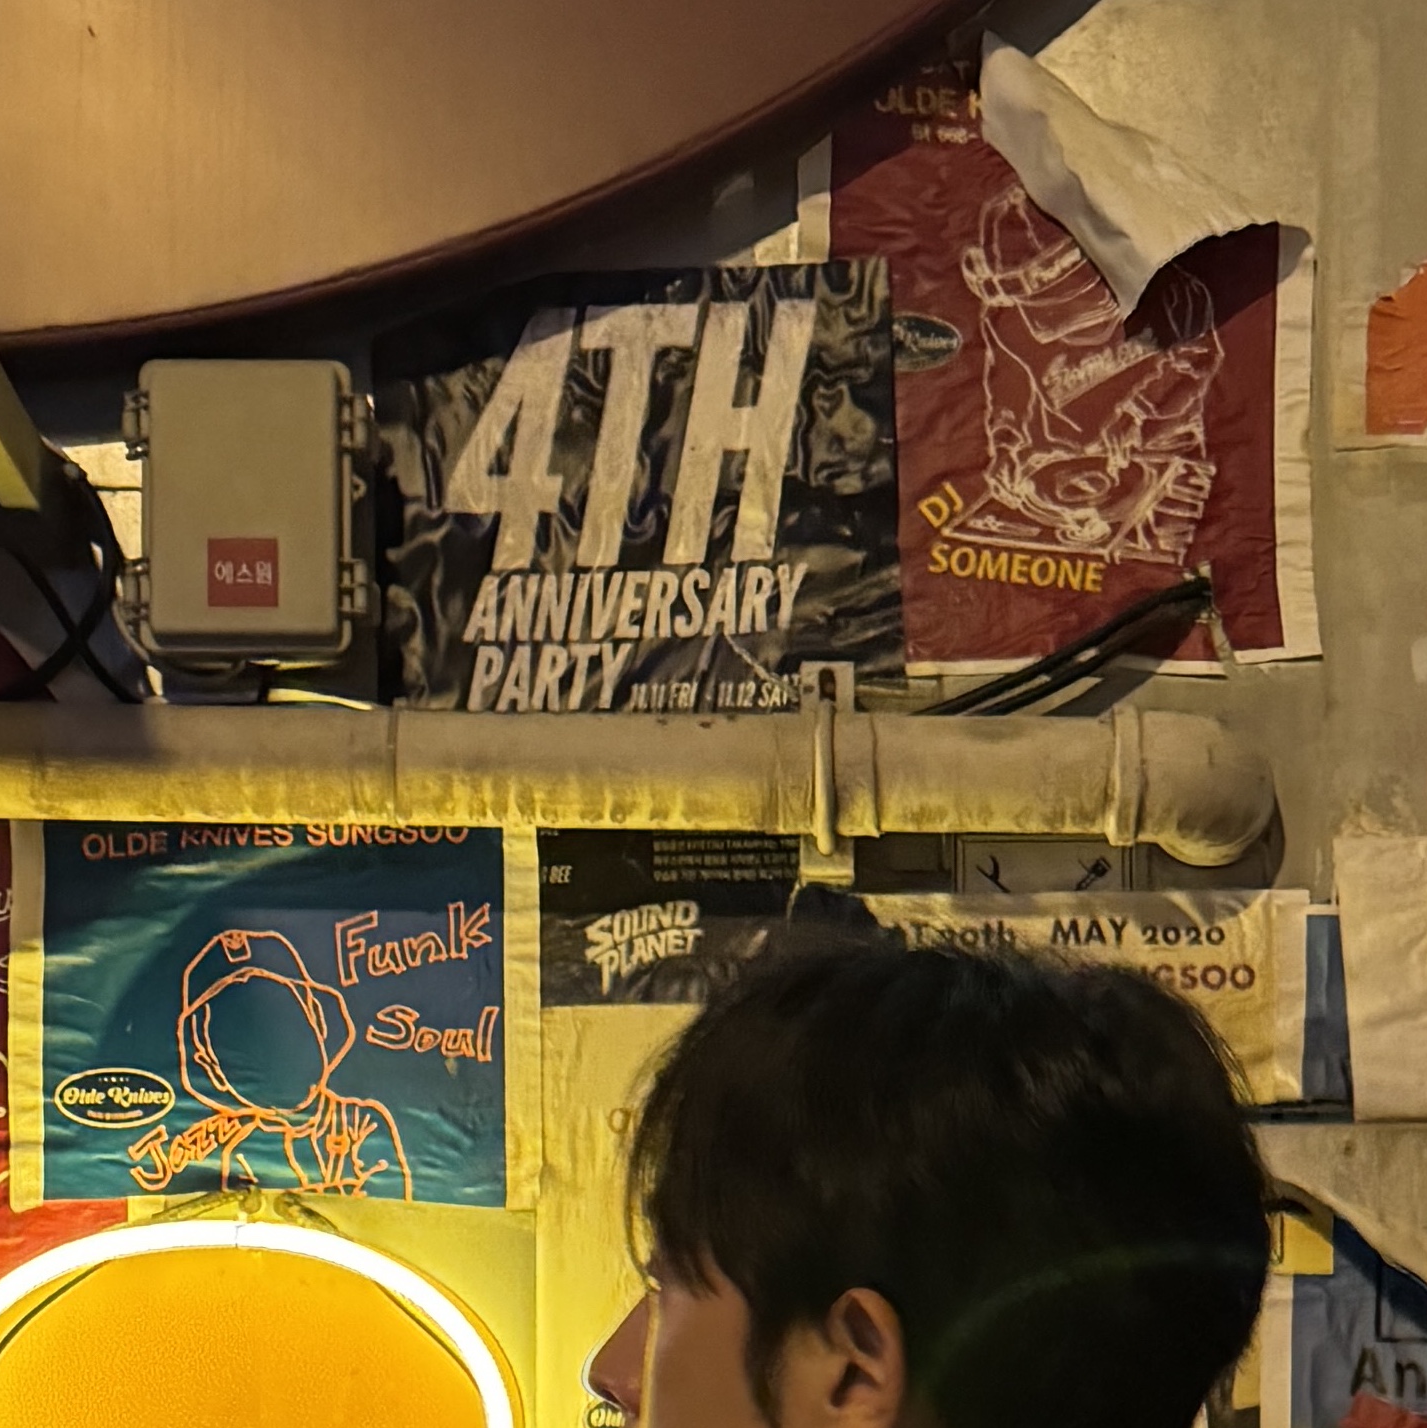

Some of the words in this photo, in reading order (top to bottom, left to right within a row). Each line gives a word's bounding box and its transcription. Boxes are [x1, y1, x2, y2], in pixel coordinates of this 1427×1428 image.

[443, 298, 818, 570] 4TH
[918, 482, 963, 529] DJ
[928, 541, 1107, 594] SOMEONE
[462, 562, 808, 644] ANNIVERSARY
[467, 642, 634, 714] PARTY
[81, 830, 168, 862] OLDE
[180, 826, 293, 850] KNIVES
[334, 901, 493, 987] Funk
[584, 899, 701, 957] SOUND
[1050, 917, 1129, 946] MAY
[1140, 926, 1226, 947] 2020
[587, 928, 704, 996] PLANET
[366, 1003, 500, 1064] Soul
[62, 1086, 106, 1108] Olde
[108, 1085, 171, 1110] Knives
[128, 1112, 246, 1192] Jazz
